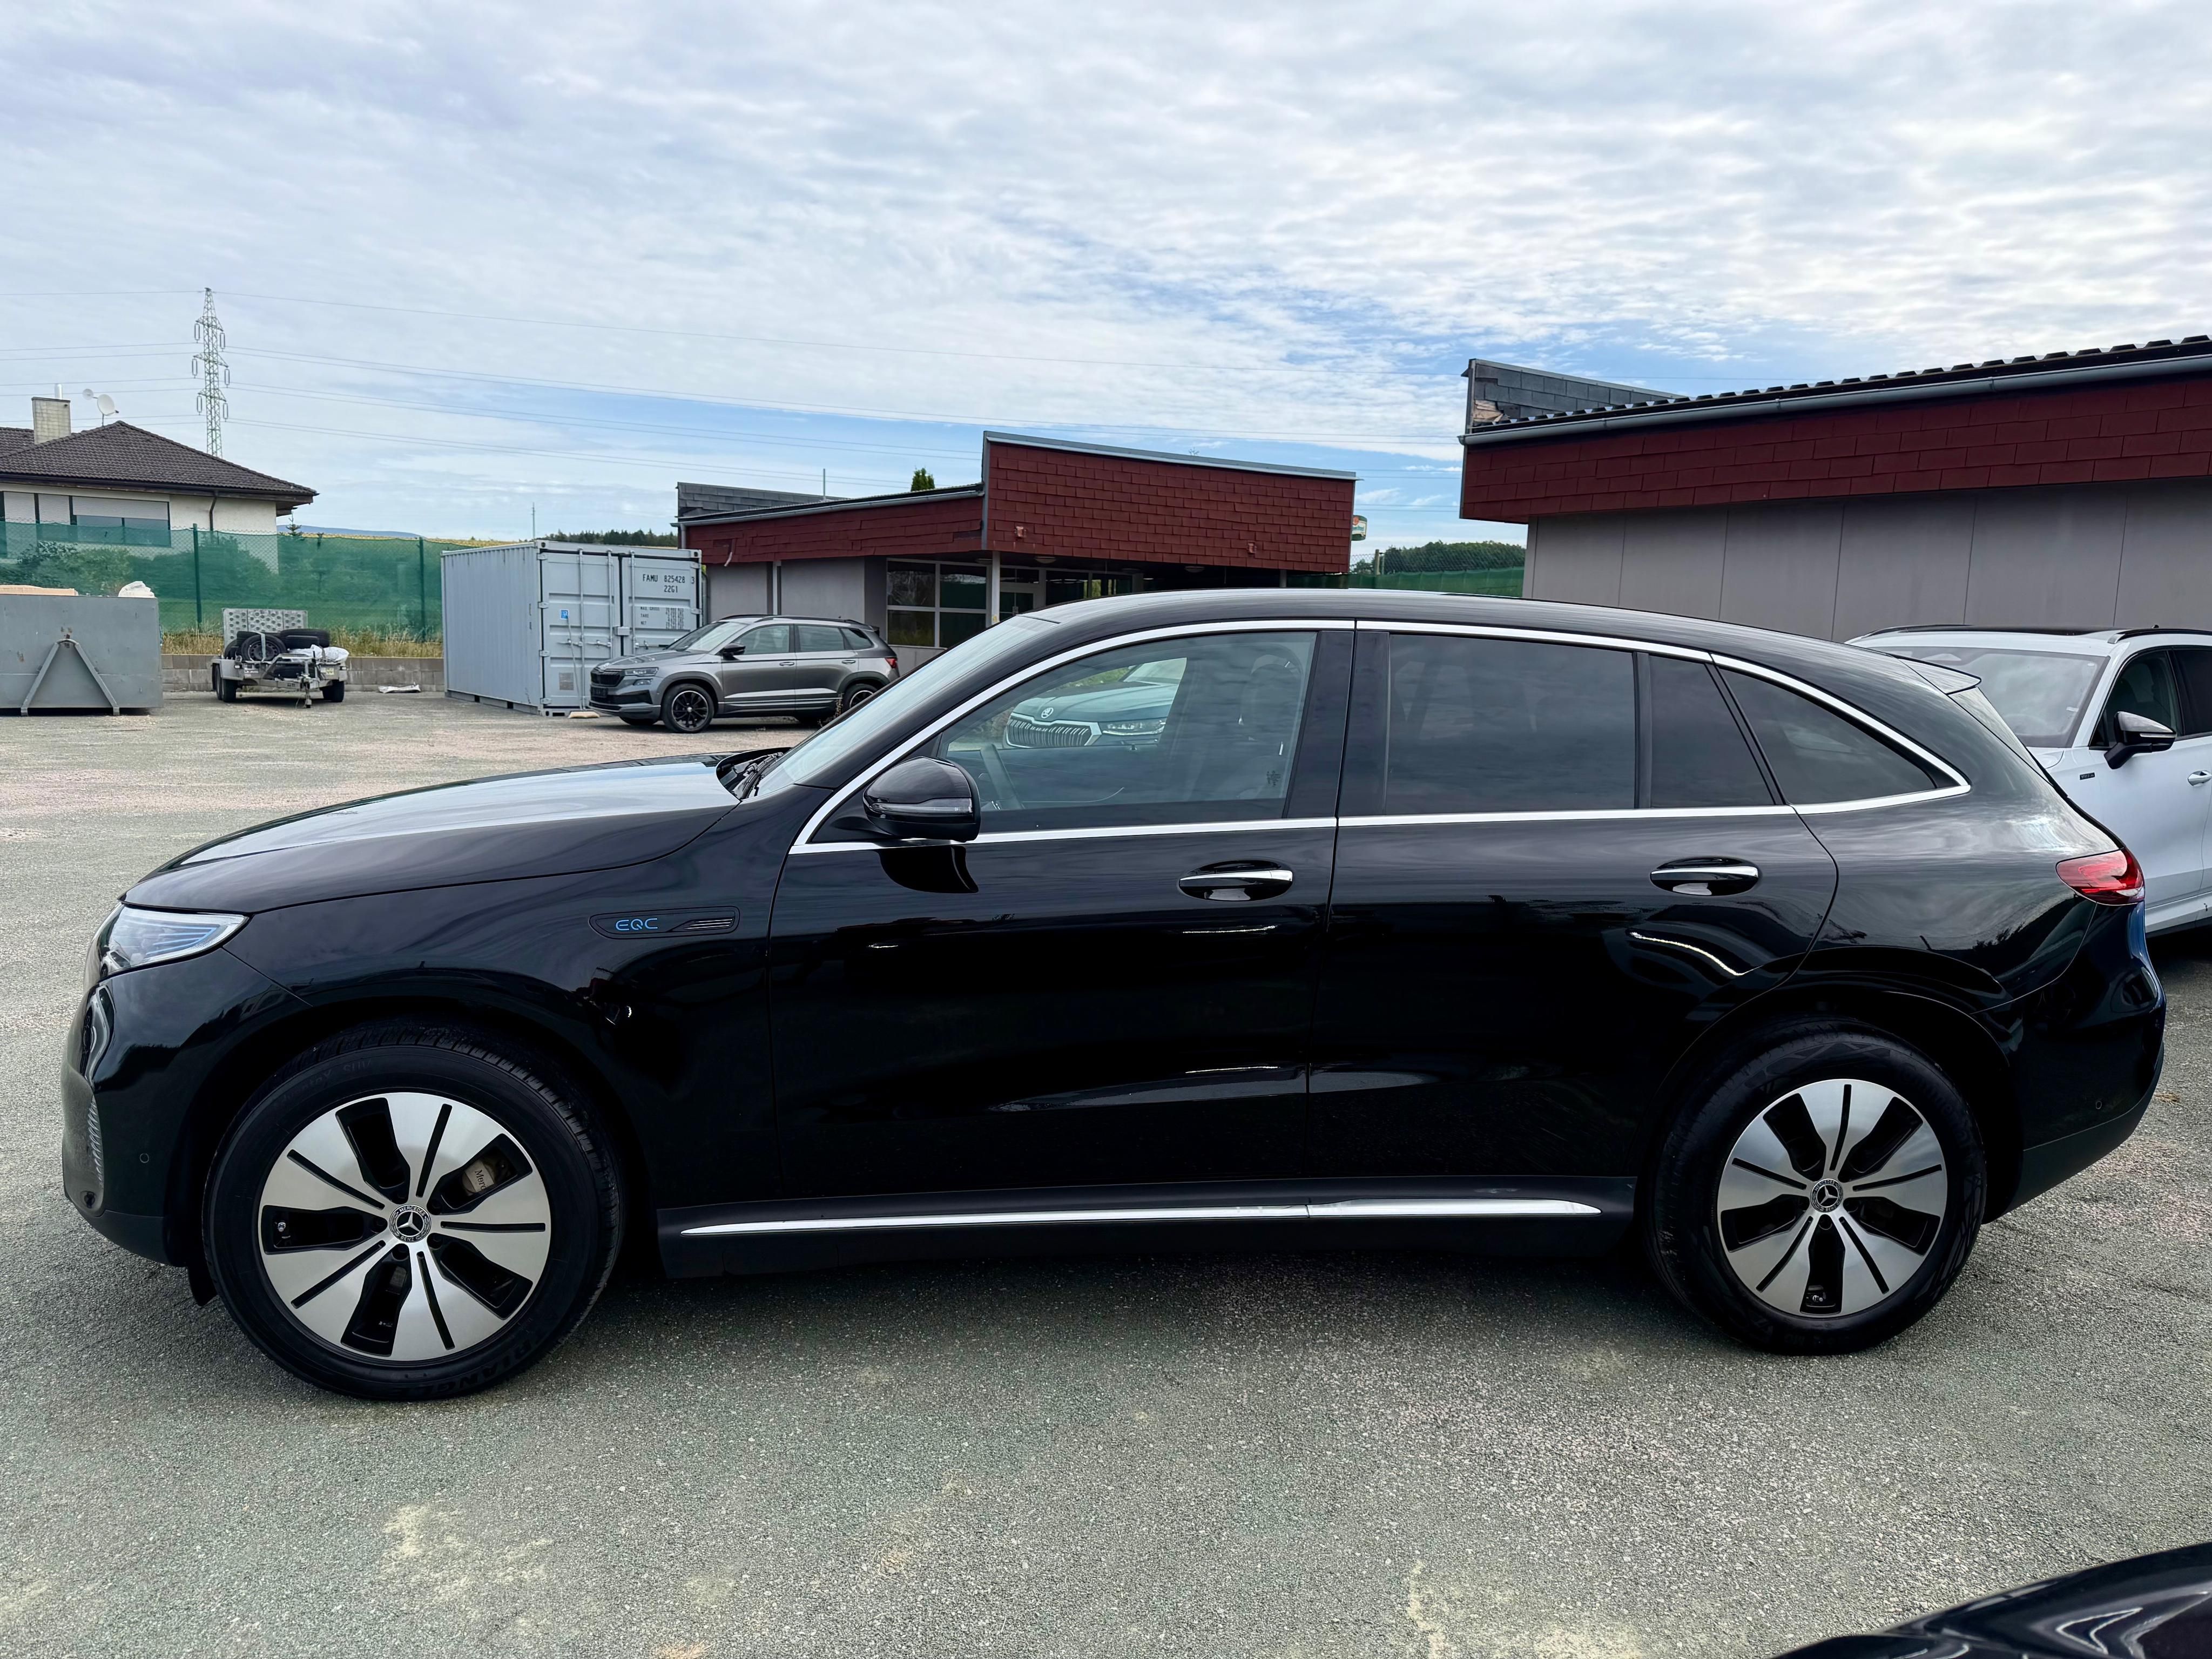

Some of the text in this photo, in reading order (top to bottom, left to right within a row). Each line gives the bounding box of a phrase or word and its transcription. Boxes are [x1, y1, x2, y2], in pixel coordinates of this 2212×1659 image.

[643, 574, 658, 582] FAMU
[664, 575, 685, 583] 825428
[616, 918, 658, 930] EQC
[399, 1206, 426, 1216] MERCEDES
